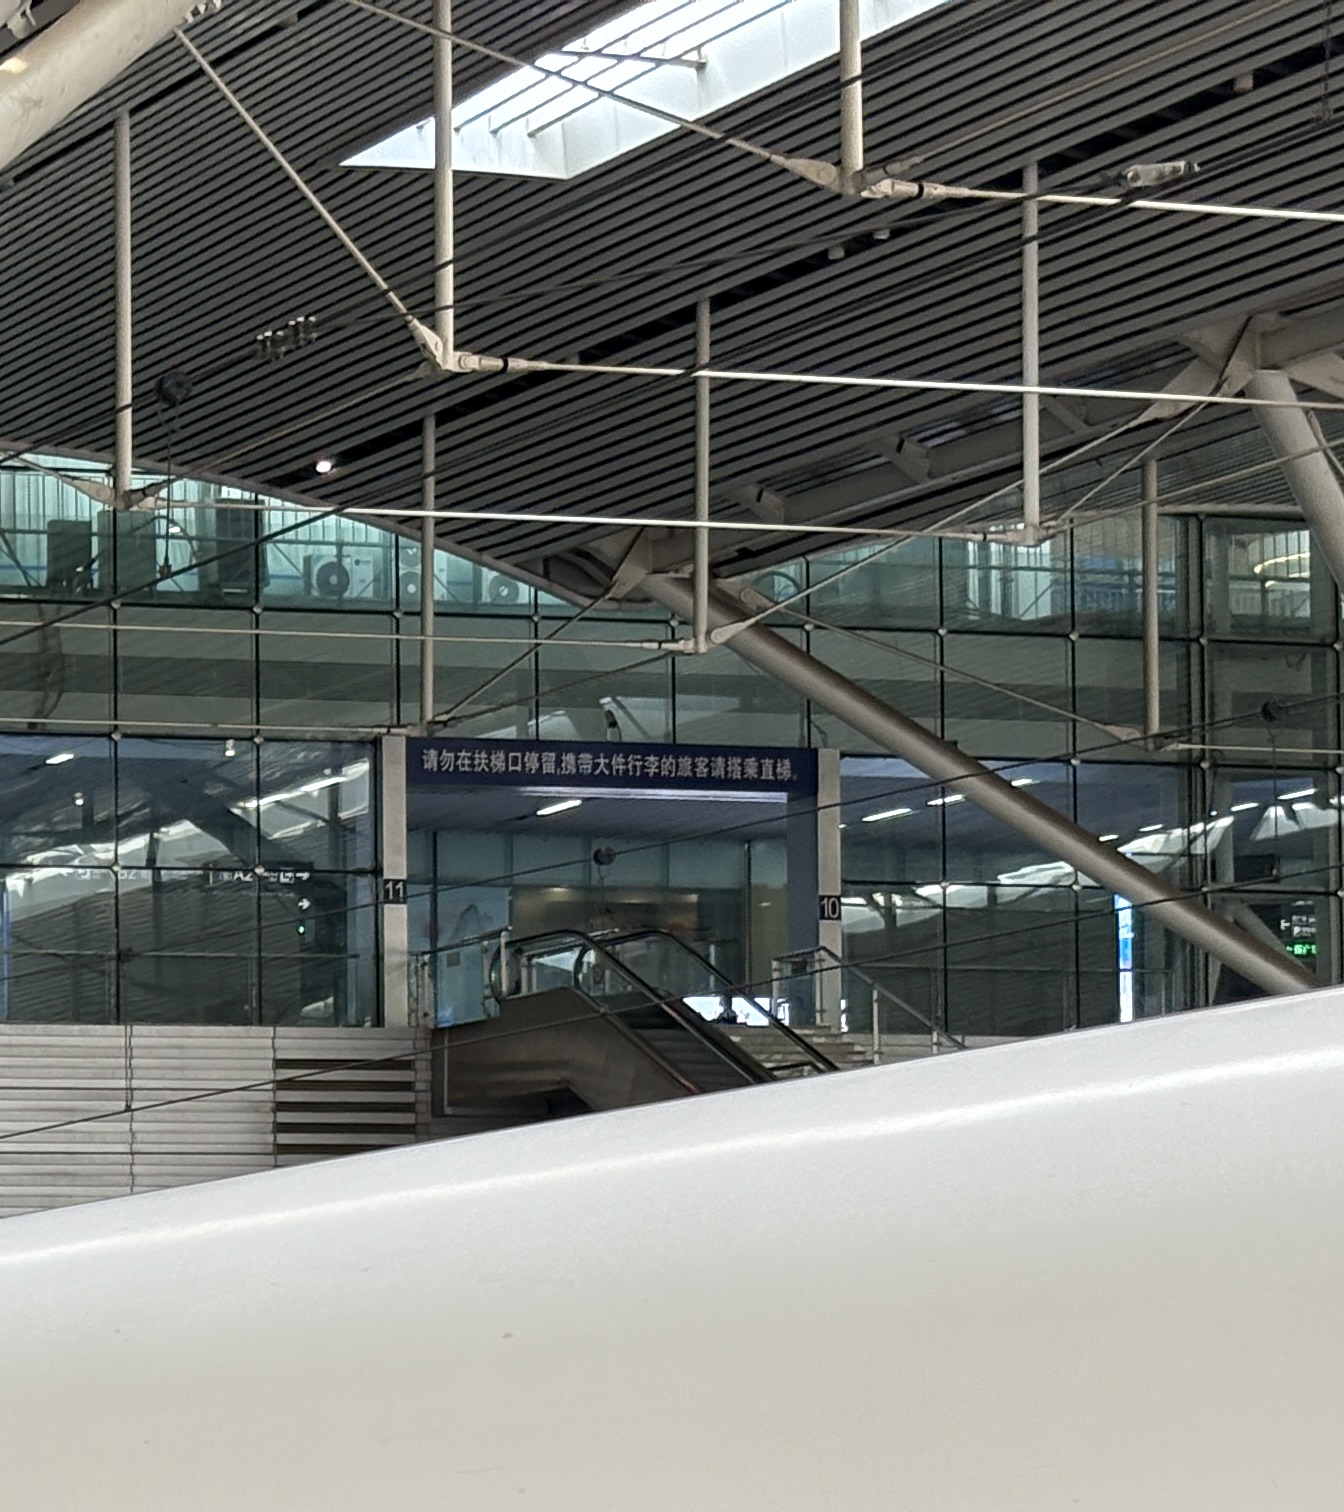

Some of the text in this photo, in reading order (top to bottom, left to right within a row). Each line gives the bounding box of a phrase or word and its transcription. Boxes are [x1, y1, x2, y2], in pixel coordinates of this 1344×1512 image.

[422, 749, 798, 782] 请勿在扶梯口停留,携带大件行李的旅客请搭乘直梯。
[384, 881, 405, 901] 11
[820, 897, 840, 919] 10
